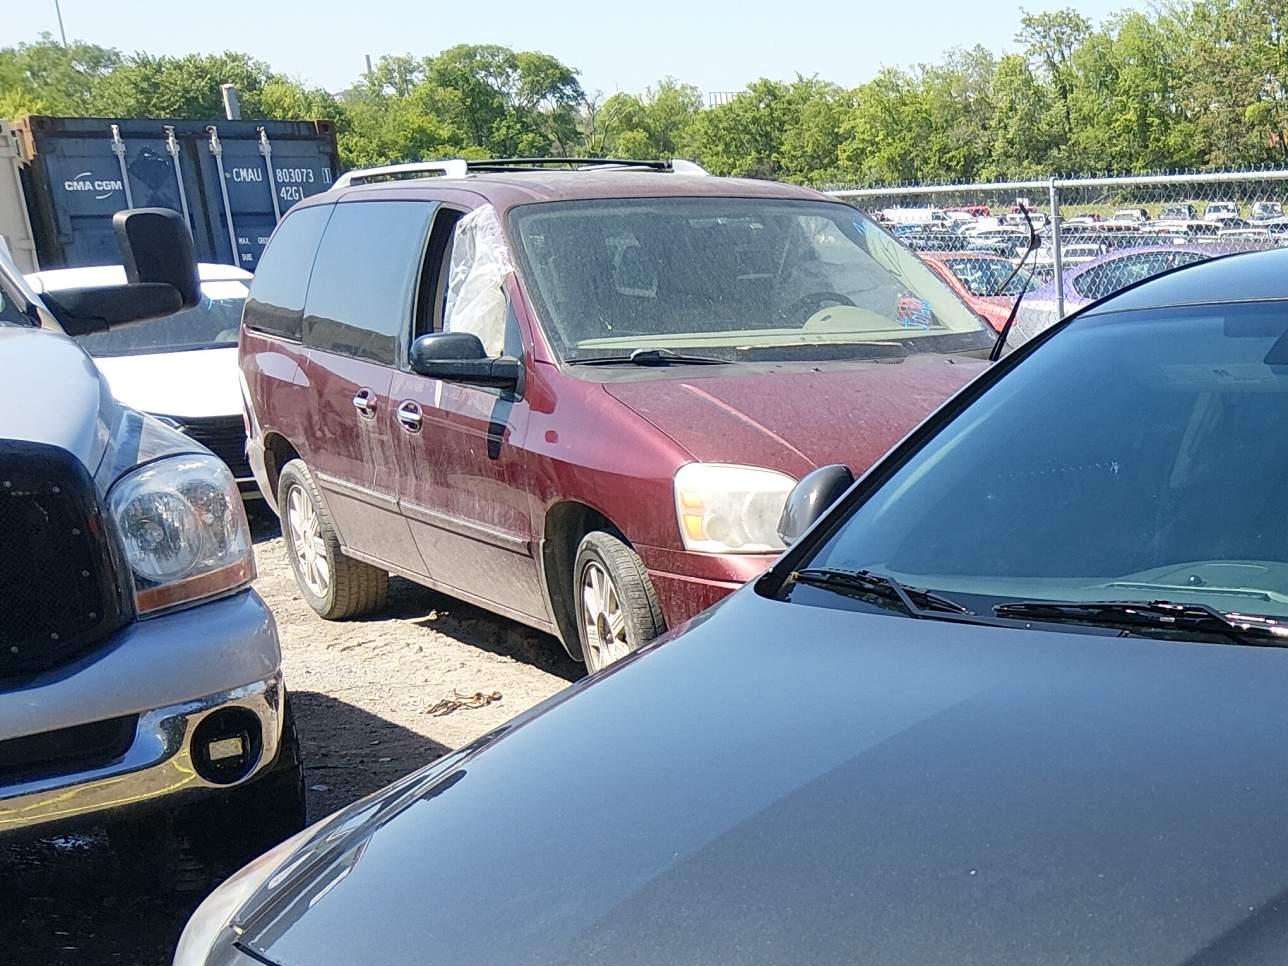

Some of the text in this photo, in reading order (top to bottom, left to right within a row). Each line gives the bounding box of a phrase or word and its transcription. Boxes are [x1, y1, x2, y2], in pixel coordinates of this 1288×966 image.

[232, 167, 263, 182] CMAU
[276, 168, 314, 183] 803073
[64, 180, 123, 191] CMA CGM
